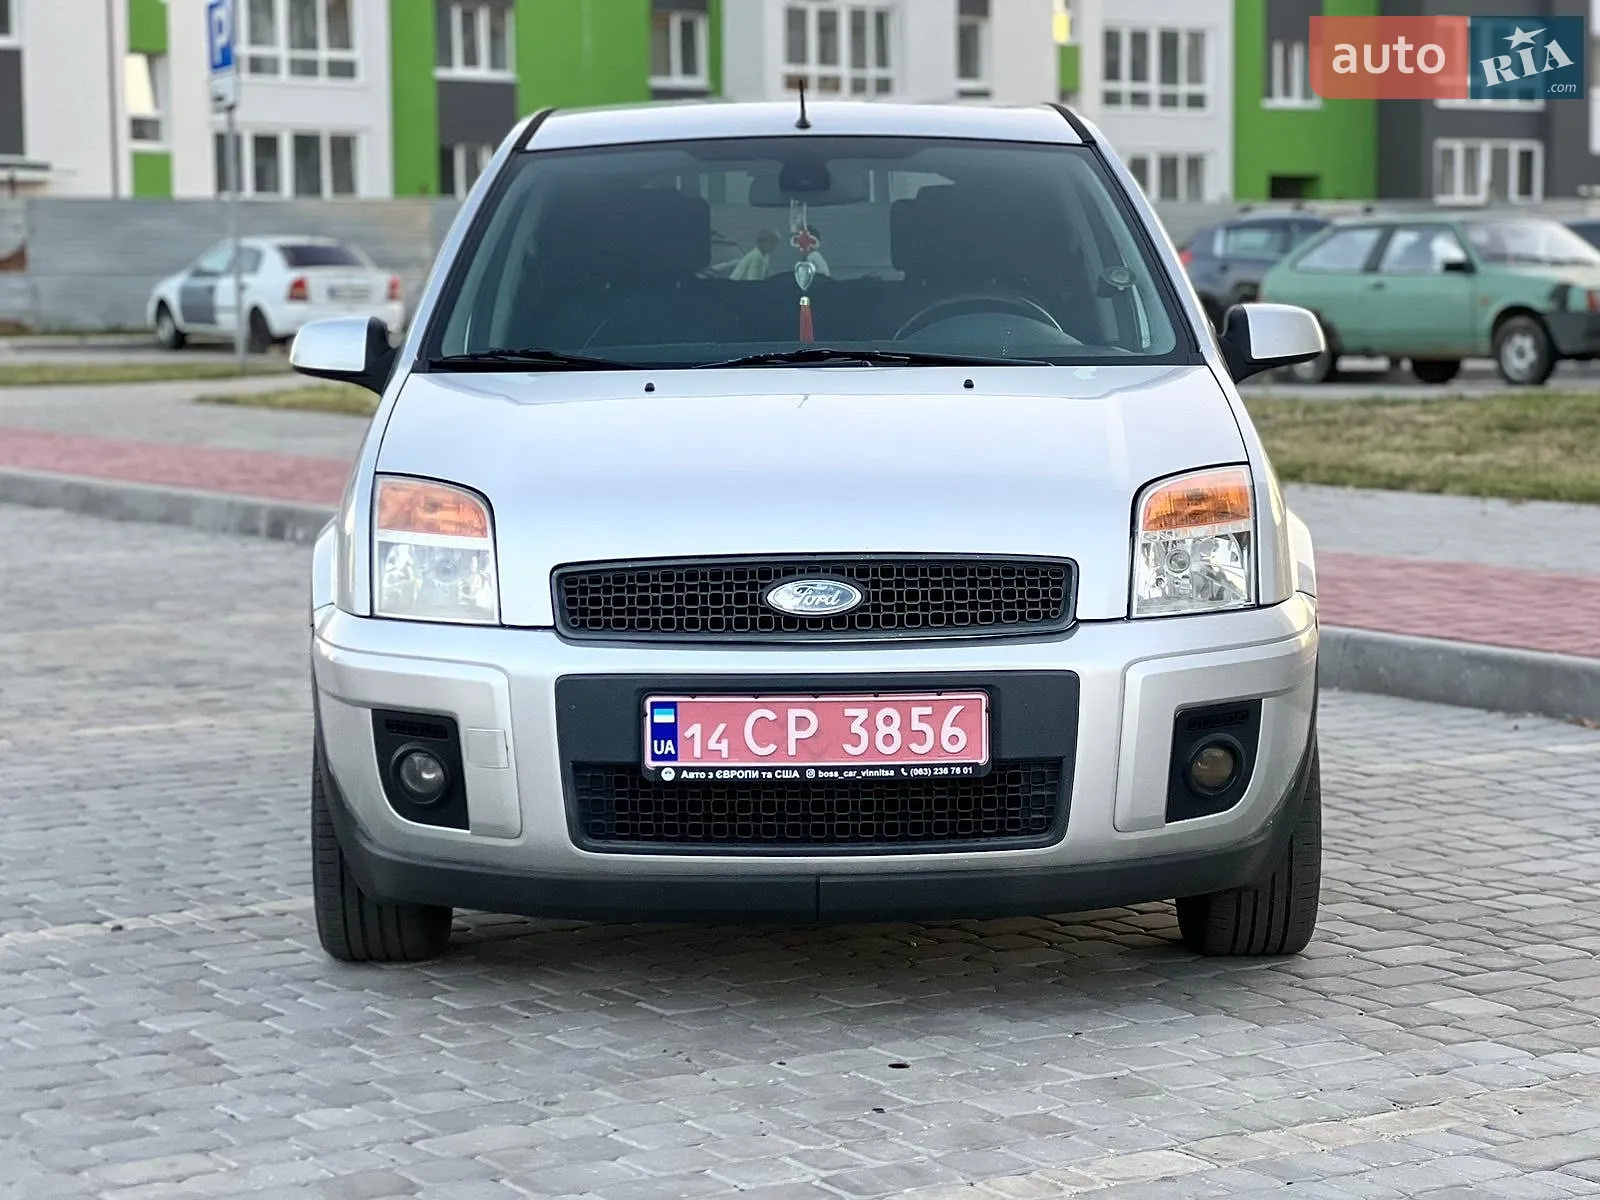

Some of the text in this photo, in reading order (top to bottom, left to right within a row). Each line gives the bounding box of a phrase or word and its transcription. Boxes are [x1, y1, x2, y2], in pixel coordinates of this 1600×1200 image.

[793, 584, 841, 606] Ford
[683, 704, 968, 759] 14 CP 3856
[653, 739, 676, 755] UA
[680, 769, 706, 779] Авто
[715, 770, 759, 779] ЄВРОПИ
[774, 769, 800, 779] США
[963, 766, 973, 774] 01
